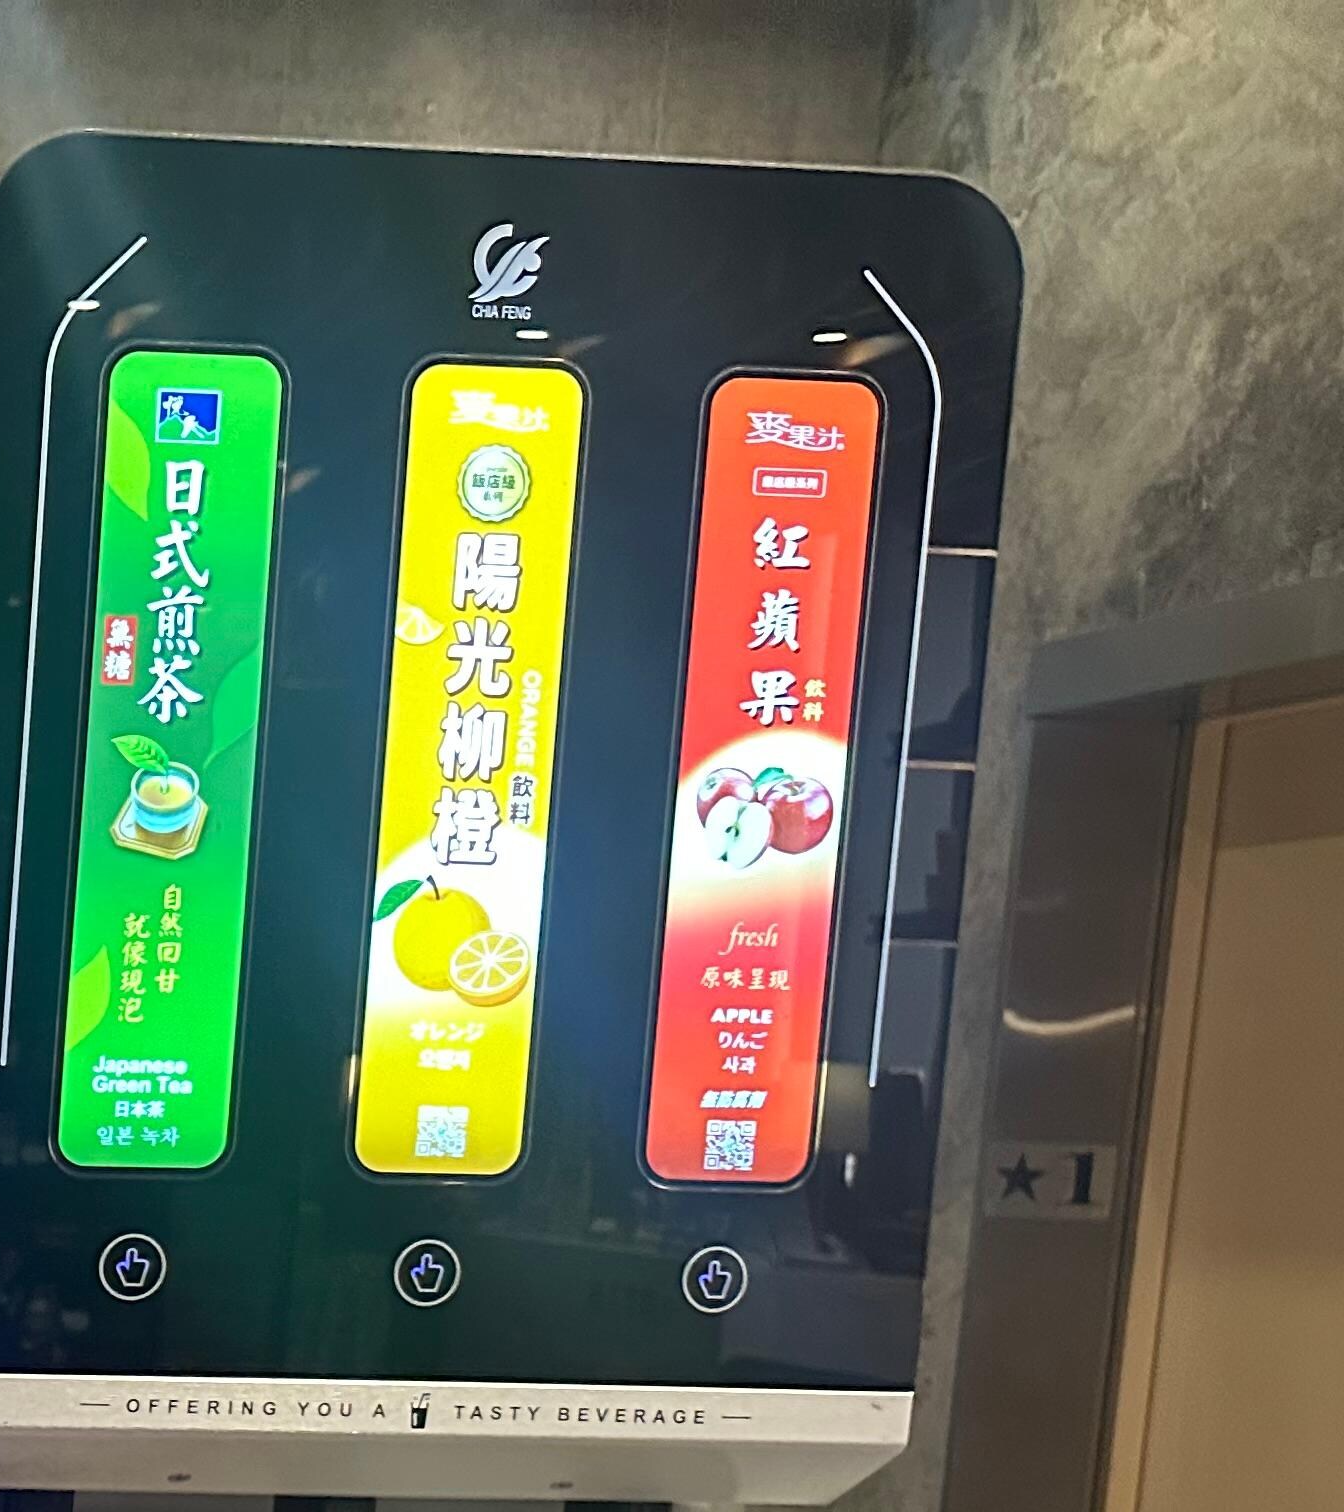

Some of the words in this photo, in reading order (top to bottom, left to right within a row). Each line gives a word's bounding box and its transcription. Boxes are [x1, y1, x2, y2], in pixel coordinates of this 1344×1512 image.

[472, 304, 499, 318] CHIA
[502, 305, 532, 320] FENG
[745, 411, 845, 452] 麥果汁
[471, 473, 516, 491] 飯店級
[137, 459, 209, 724] 日式煎茶
[740, 517, 810, 727] 紅蘋果
[103, 618, 135, 681] 無糖
[431, 532, 522, 866] 陽光柳橙
[802, 678, 827, 722] 飲料
[515, 669, 542, 766] ORANGE
[510, 775, 533, 825] 飲料
[154, 883, 184, 994] 自然回甘
[717, 921, 779, 956] fresh
[117, 913, 151, 1024] 就像現泡
[700, 966, 792, 991] 原味呈現
[710, 1007, 774, 1025] APPLE
[410, 1021, 485, 1043] オレンジ
[718, 1031, 769, 1050] りんご
[92, 1054, 188, 1078] Japanese
[722, 1056, 757, 1075] 사과
[91, 1074, 152, 1094] Green
[155, 1075, 193, 1095] Tea
[114, 1099, 166, 1118] 日本茶
[96, 1125, 135, 1146] 일본
[139, 1126, 181, 1148] 녹차
[126, 1398, 277, 1416] OFFERING
[297, 1401, 353, 1417] YOU
[372, 1403, 387, 1419] A
[453, 1405, 540, 1421] TASTY
[557, 1407, 706, 1425] BEVERAGE
